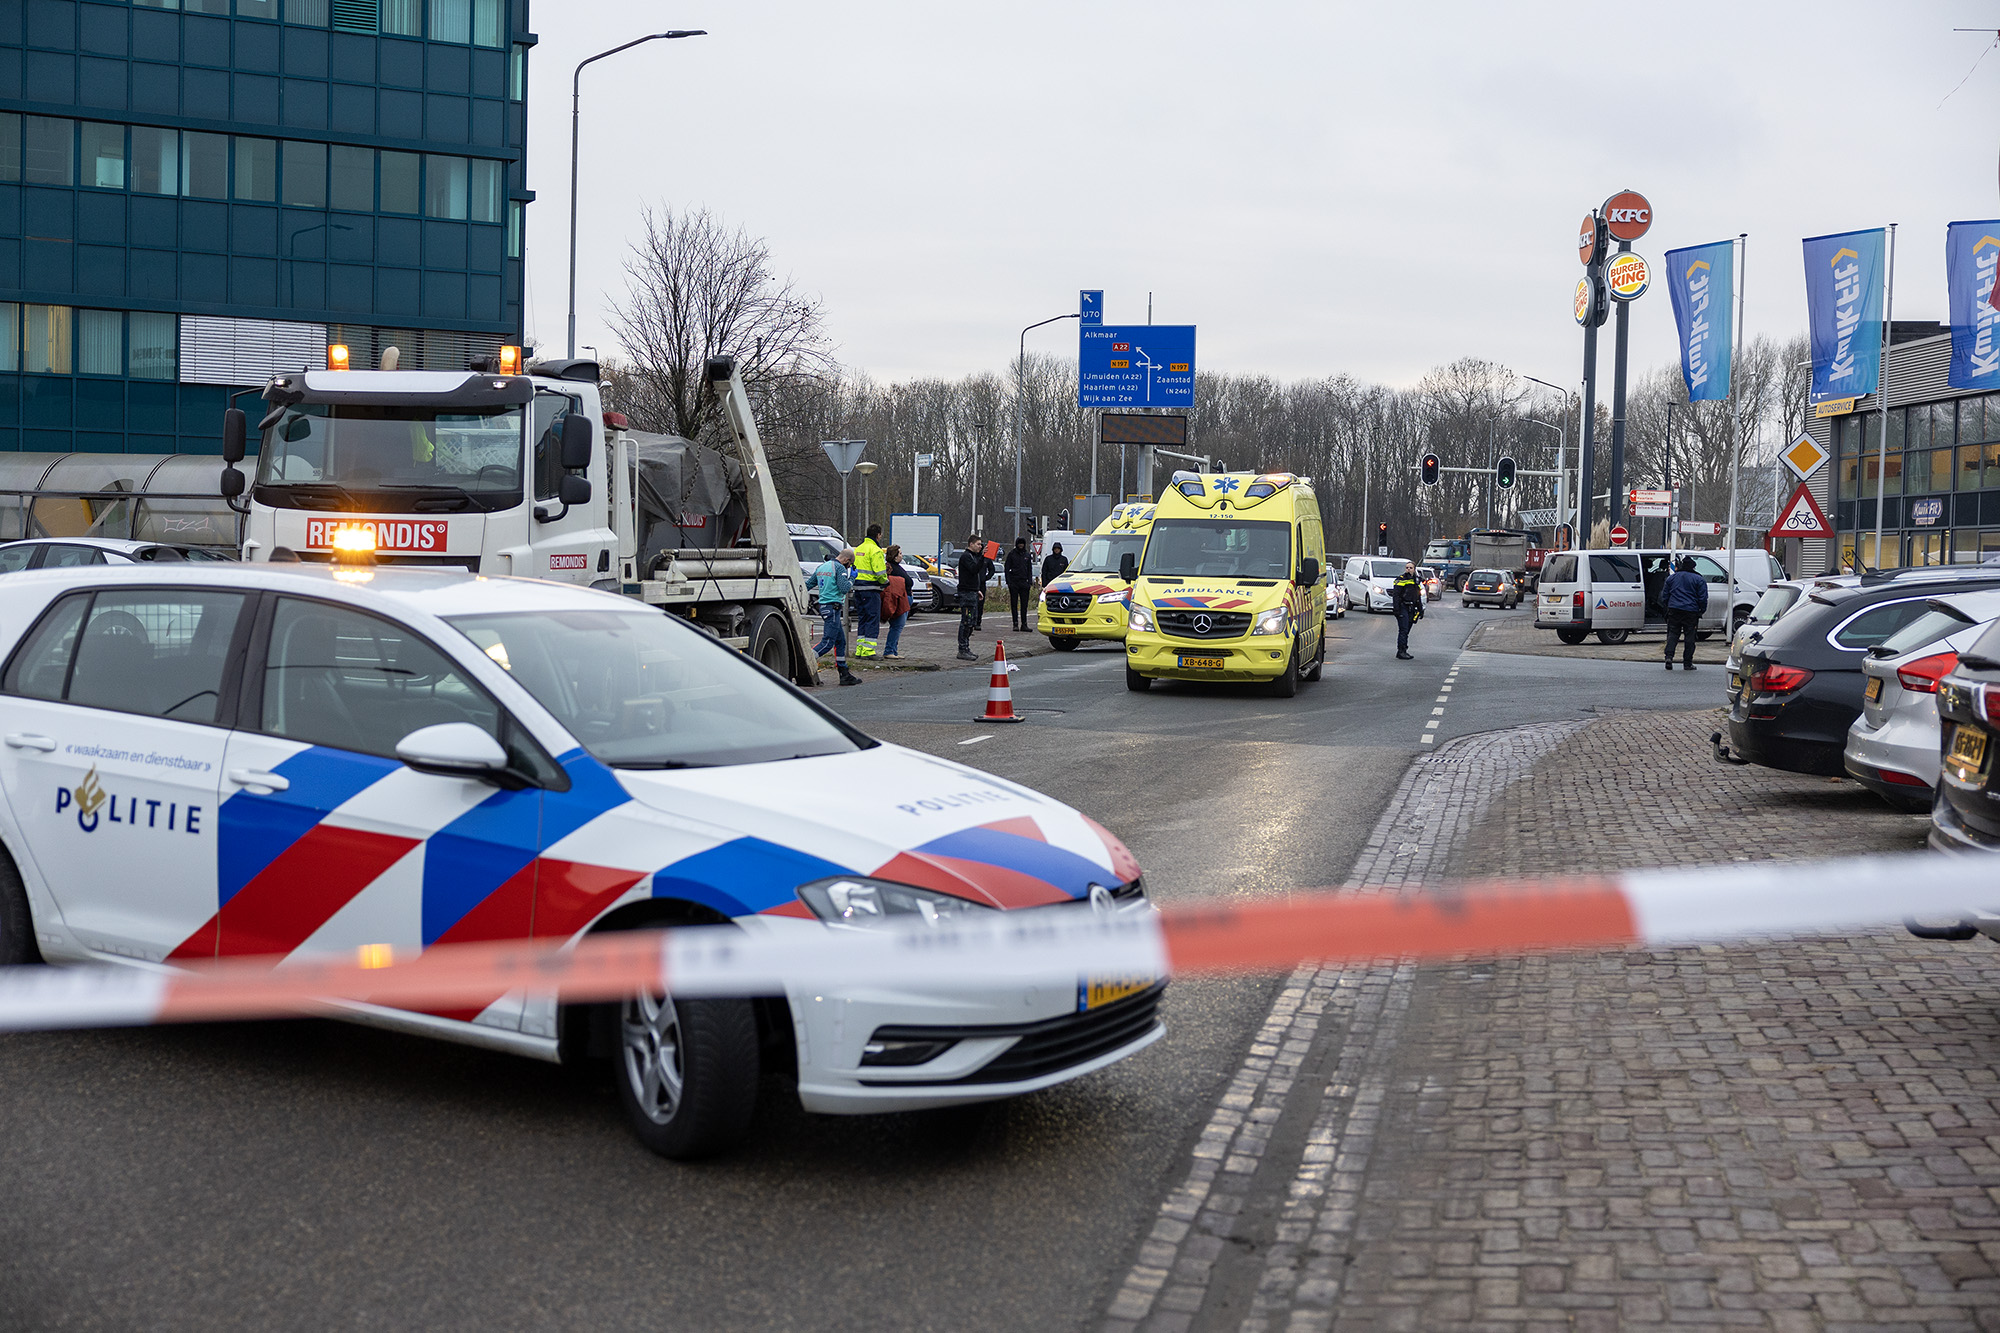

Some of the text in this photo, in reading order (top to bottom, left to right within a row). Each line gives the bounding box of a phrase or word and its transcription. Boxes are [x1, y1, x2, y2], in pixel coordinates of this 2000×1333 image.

[1609, 208, 1649, 223] KFC
[1610, 262, 1645, 278] BURGER
[1611, 270, 1646, 289] KING
[1156, 376, 1191, 384] Zaanstad
[1083, 395, 1100, 403] Wijk
[1817, 401, 1852, 414] AUTOSERVICE
[1163, 588, 1254, 597] AMBULANCE
[1184, 658, 1221, 667] XB-648-G
[74, 744, 129, 761] waakzaam
[130, 754, 144, 763] en
[145, 752, 203, 771] dienstbaar
[56, 786, 202, 834] POLITIE
[896, 791, 1011, 816] POLITIE
